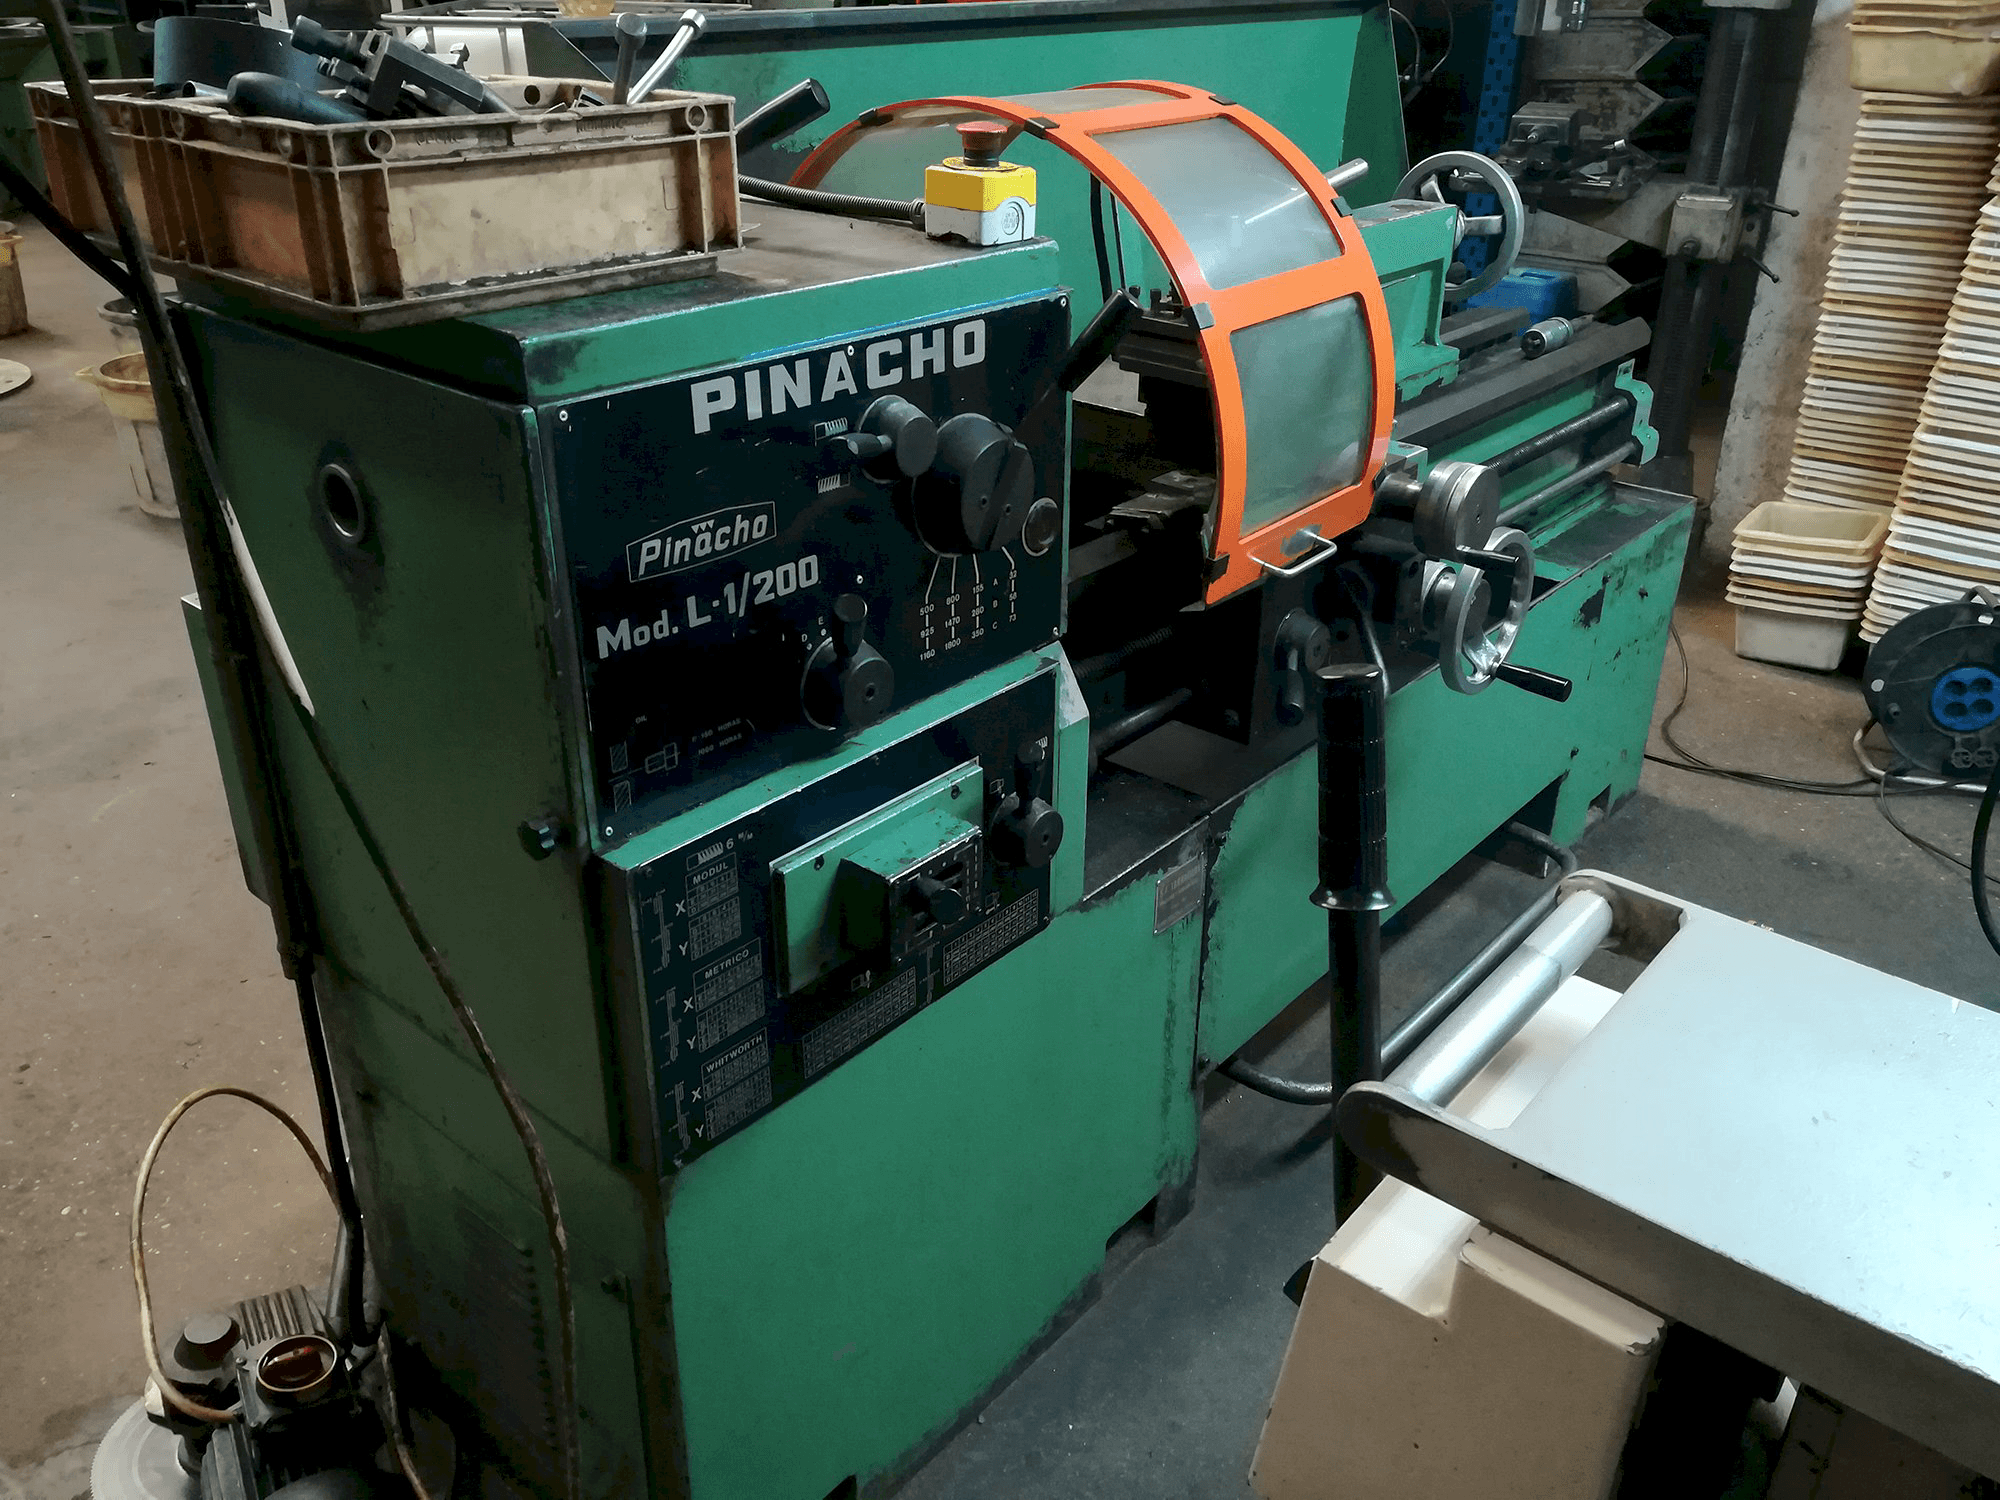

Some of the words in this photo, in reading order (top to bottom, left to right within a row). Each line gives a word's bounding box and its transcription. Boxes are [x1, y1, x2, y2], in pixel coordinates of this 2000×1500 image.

[690, 319, 986, 434] PINACHO
[596, 609, 679, 659] Mod.
[686, 554, 819, 628] L-1/200
[920, 604, 935, 616] 500
[946, 594, 960, 605] 800
[973, 584, 984, 594] 155
[993, 578, 998, 586] A
[818, 616, 824, 625] E
[920, 626, 935, 638] 925
[945, 616, 960, 628] 1470
[971, 606, 985, 617] 280
[945, 638, 961, 650] 1800
[971, 628, 985, 639] 350
[992, 621, 998, 630] C
[726, 838, 734, 850] 6
[692, 861, 729, 886] MODUL
[675, 899, 686, 917] X
[679, 941, 688, 956] Y
[703, 948, 750, 980] METRICO
[683, 997, 693, 1013] X
[687, 1035, 697, 1050] Y
[706, 1034, 763, 1073] WHITWORTH
[692, 1087, 702, 1103] X
[695, 1124, 705, 1139] Y
